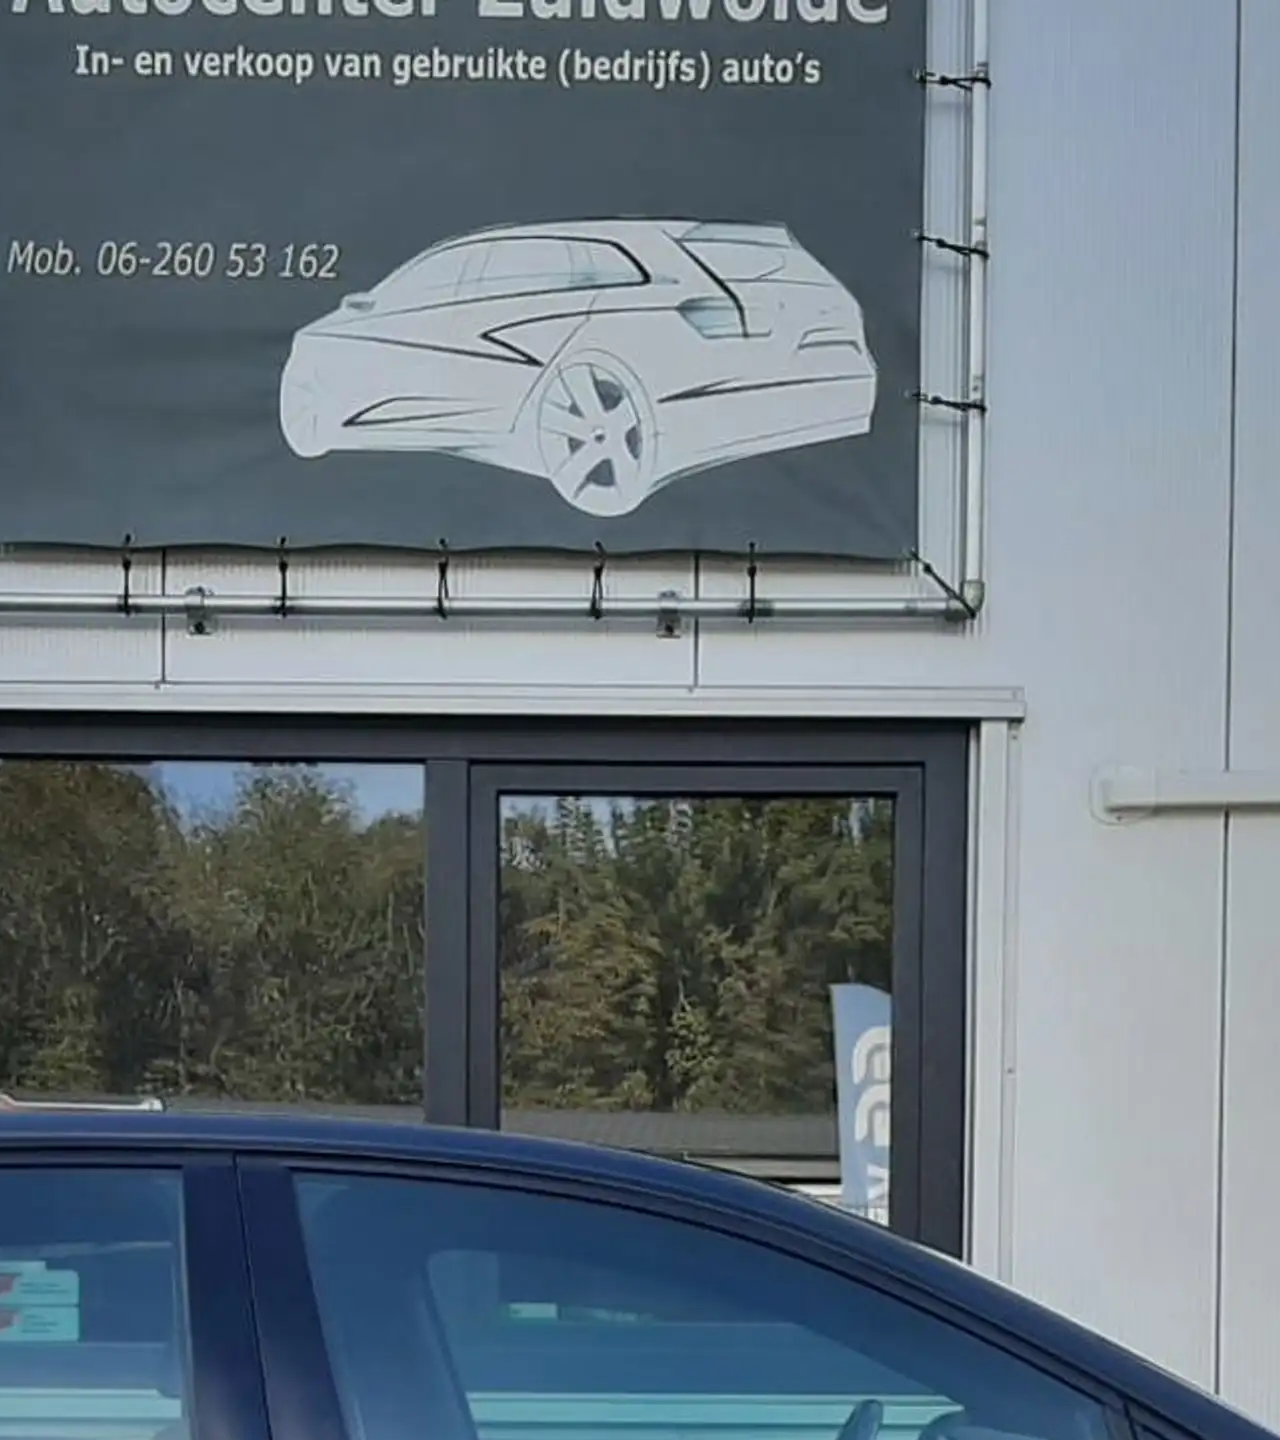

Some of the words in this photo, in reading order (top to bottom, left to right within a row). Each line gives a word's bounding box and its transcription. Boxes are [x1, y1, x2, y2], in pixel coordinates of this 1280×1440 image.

[75, 44, 124, 75] In-
[134, 51, 173, 76] en
[184, 45, 314, 85] verkoop
[324, 53, 381, 78] van
[392, 46, 547, 86] gebruikte
[558, 48, 710, 90] (bedrijfs)
[722, 51, 821, 84] auto’s
[7, 239, 82, 275] Mob.
[97, 241, 214, 277] 06-260
[226, 242, 266, 278] 53
[279, 243, 339, 279] 162
